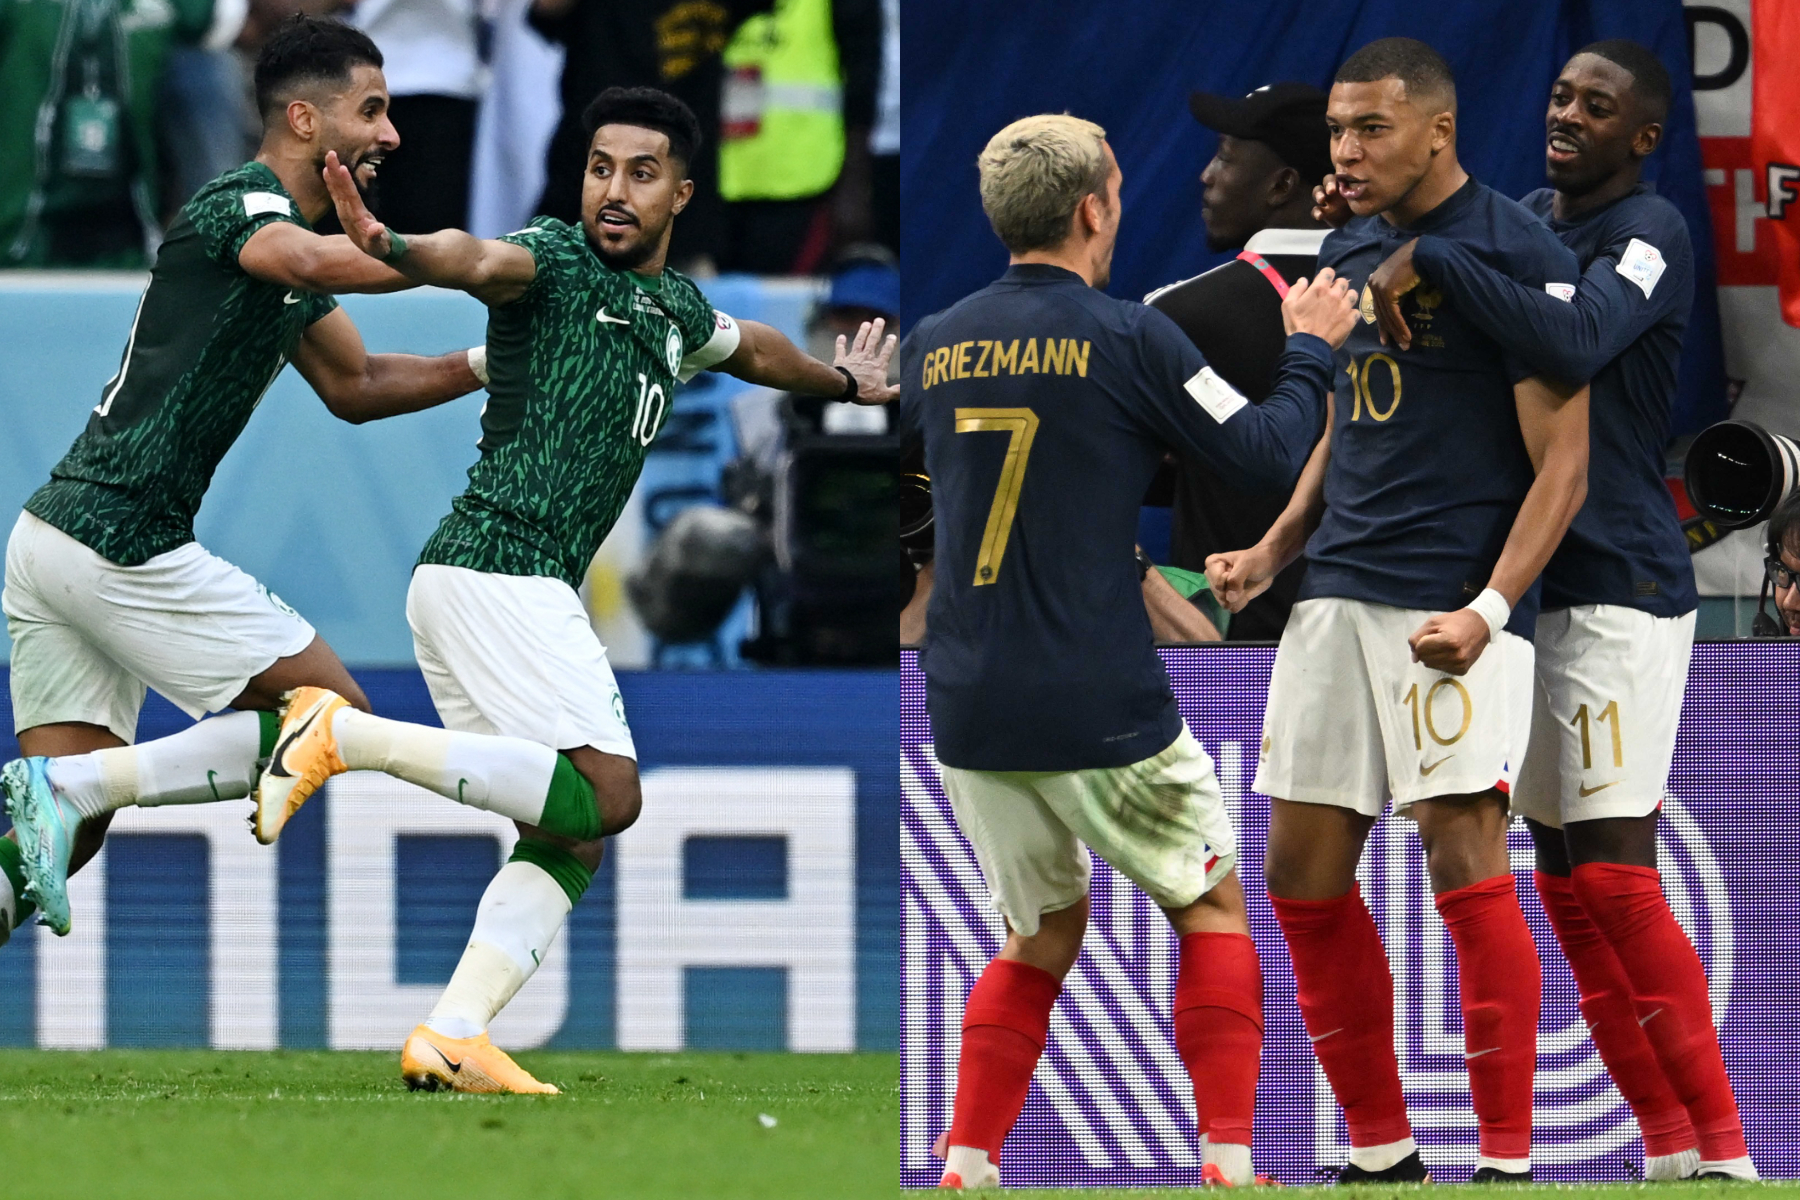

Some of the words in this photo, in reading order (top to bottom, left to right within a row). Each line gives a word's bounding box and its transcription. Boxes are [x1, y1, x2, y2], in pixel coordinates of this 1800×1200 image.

[922, 337, 1091, 390] GRIEZMANN
[1346, 353, 1402, 421] 10
[631, 373, 665, 447] 10
[954, 407, 1040, 586] 7
[1402, 677, 1472, 751] 10
[1570, 700, 1623, 769] 11
